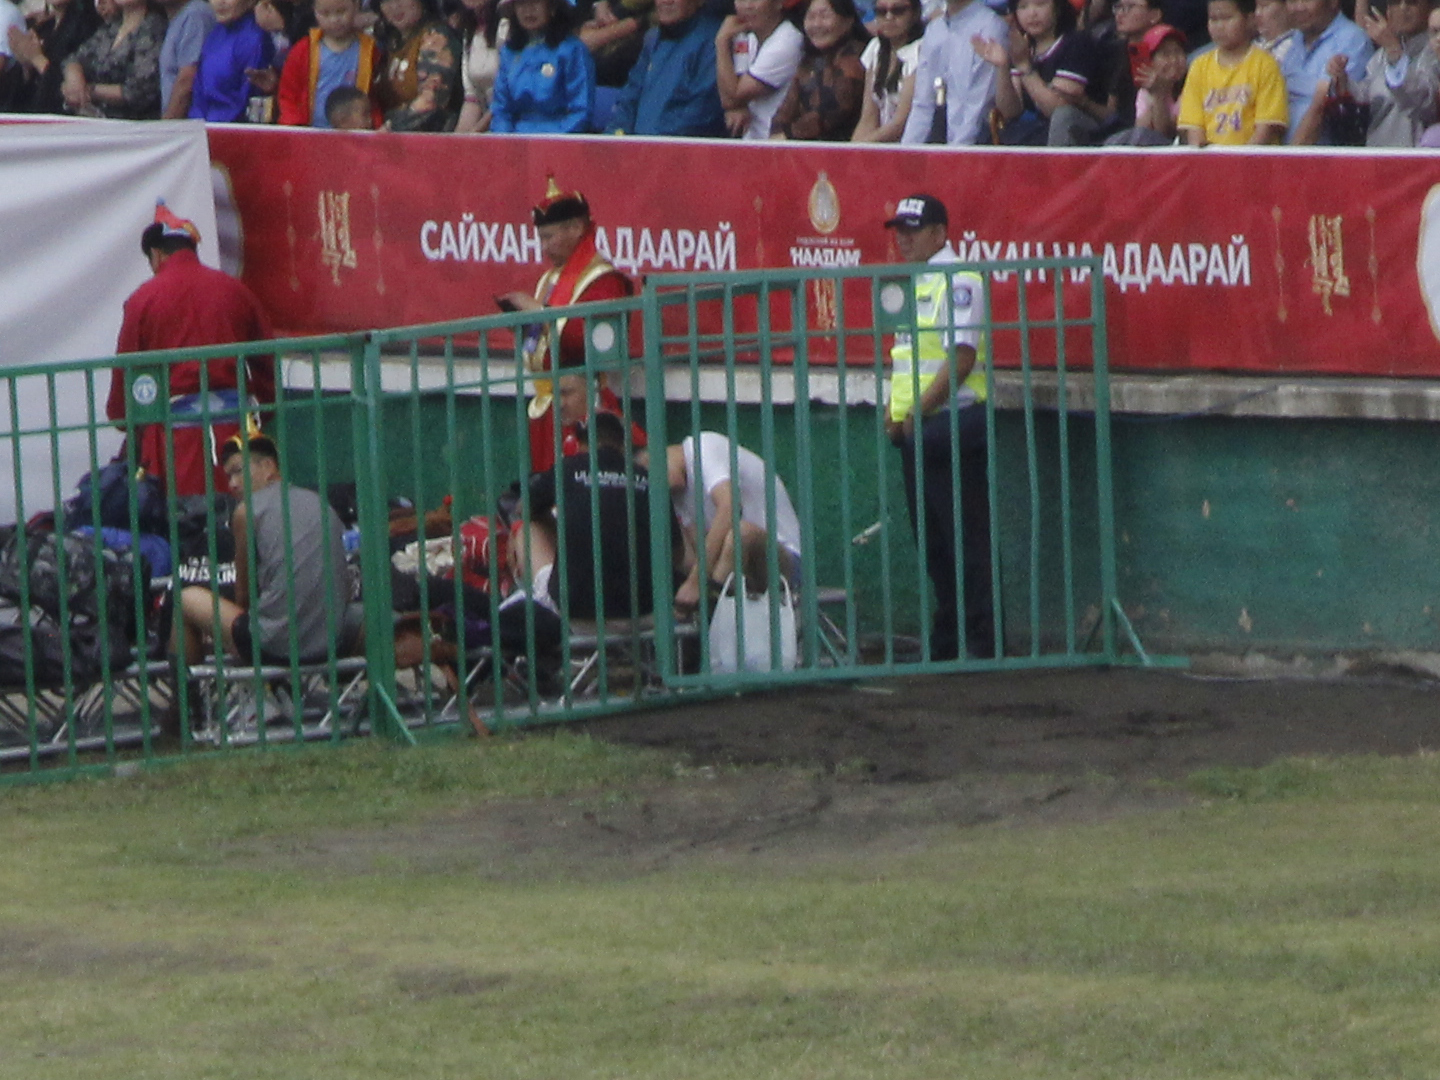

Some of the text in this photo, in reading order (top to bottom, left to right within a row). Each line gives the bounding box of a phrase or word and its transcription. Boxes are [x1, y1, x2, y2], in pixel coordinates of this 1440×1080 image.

[1215, 111, 1242, 134] 24
[420, 212, 737, 275] САЙХАН АДААРАЙ
[944, 230, 1047, 284] ЙХАН
